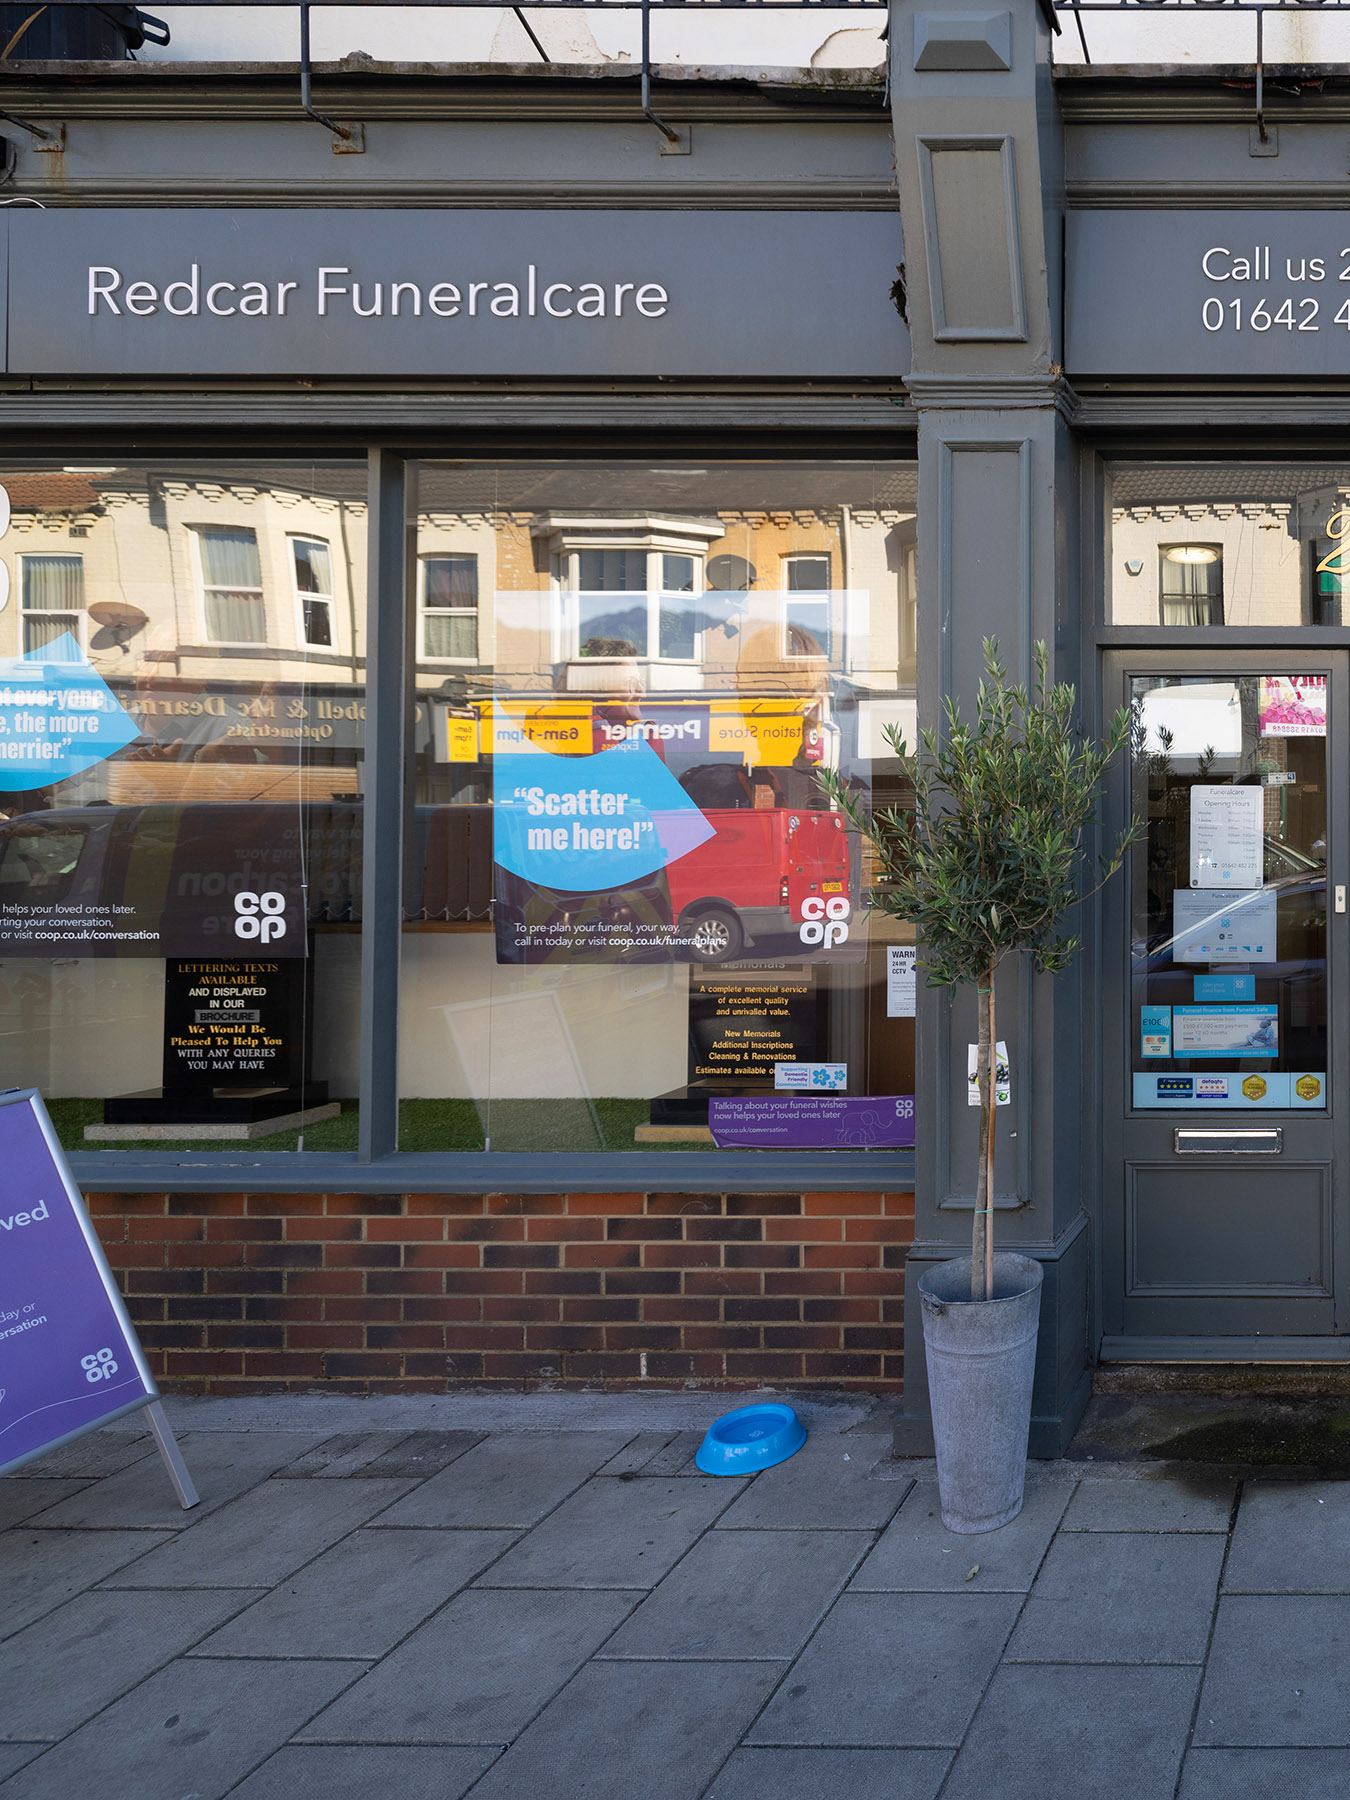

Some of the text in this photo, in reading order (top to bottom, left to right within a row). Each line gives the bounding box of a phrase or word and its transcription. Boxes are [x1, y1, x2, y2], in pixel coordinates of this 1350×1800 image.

[1202, 246, 1269, 281] Call
[1286, 257, 1325, 281] us
[88, 264, 669, 318] Redcar Funeralcare
[1202, 298, 1319, 331] 01642
[18, 689, 104, 710] everyone
[14, 712, 98, 733] the more
[1204, 800, 1230, 808] Opening
[528, 828, 568, 850] me
[3, 904, 136, 916] helps your loved ones later.
[24, 918, 114, 929] your conversation,
[515, 922, 680, 934] To pre-plan your funeral, your way,
[14, 930, 32, 939] visit
[35, 930, 160, 942] coop.co.uk/conversation
[514, 936, 531, 946] call
[534, 937, 542, 946] in
[546, 936, 572, 948] today
[588, 937, 606, 946] visit
[609, 936, 727, 948] coop.co.uk/funeralplans
[179, 964, 279, 972] LETTERING TEXTS
[199, 976, 257, 984] AVAILABLE
[189, 988, 267, 996] AND DISPLAYED
[708, 986, 742, 994] complete
[210, 1000, 245, 1008] IN OUR
[188, 1025, 266, 1033] We Would Be
[171, 1037, 282, 1047] Pleased To Help You
[751, 1042, 793, 1050] Inscriptions
[178, 1049, 276, 1057] WITH ANY QUERIES
[709, 1053, 740, 1061] Cleaning
[188, 1061, 265, 1069] YOU MAY HAVE
[714, 1101, 847, 1111] Talking about your funeral wishes
[734, 1111, 755, 1121] helps
[777, 1111, 800, 1119] loved
[714, 1126, 788, 1134] coop.co.uk/conversation
[0, 1200, 50, 1230] ved
[23, 1302, 36, 1313] or
